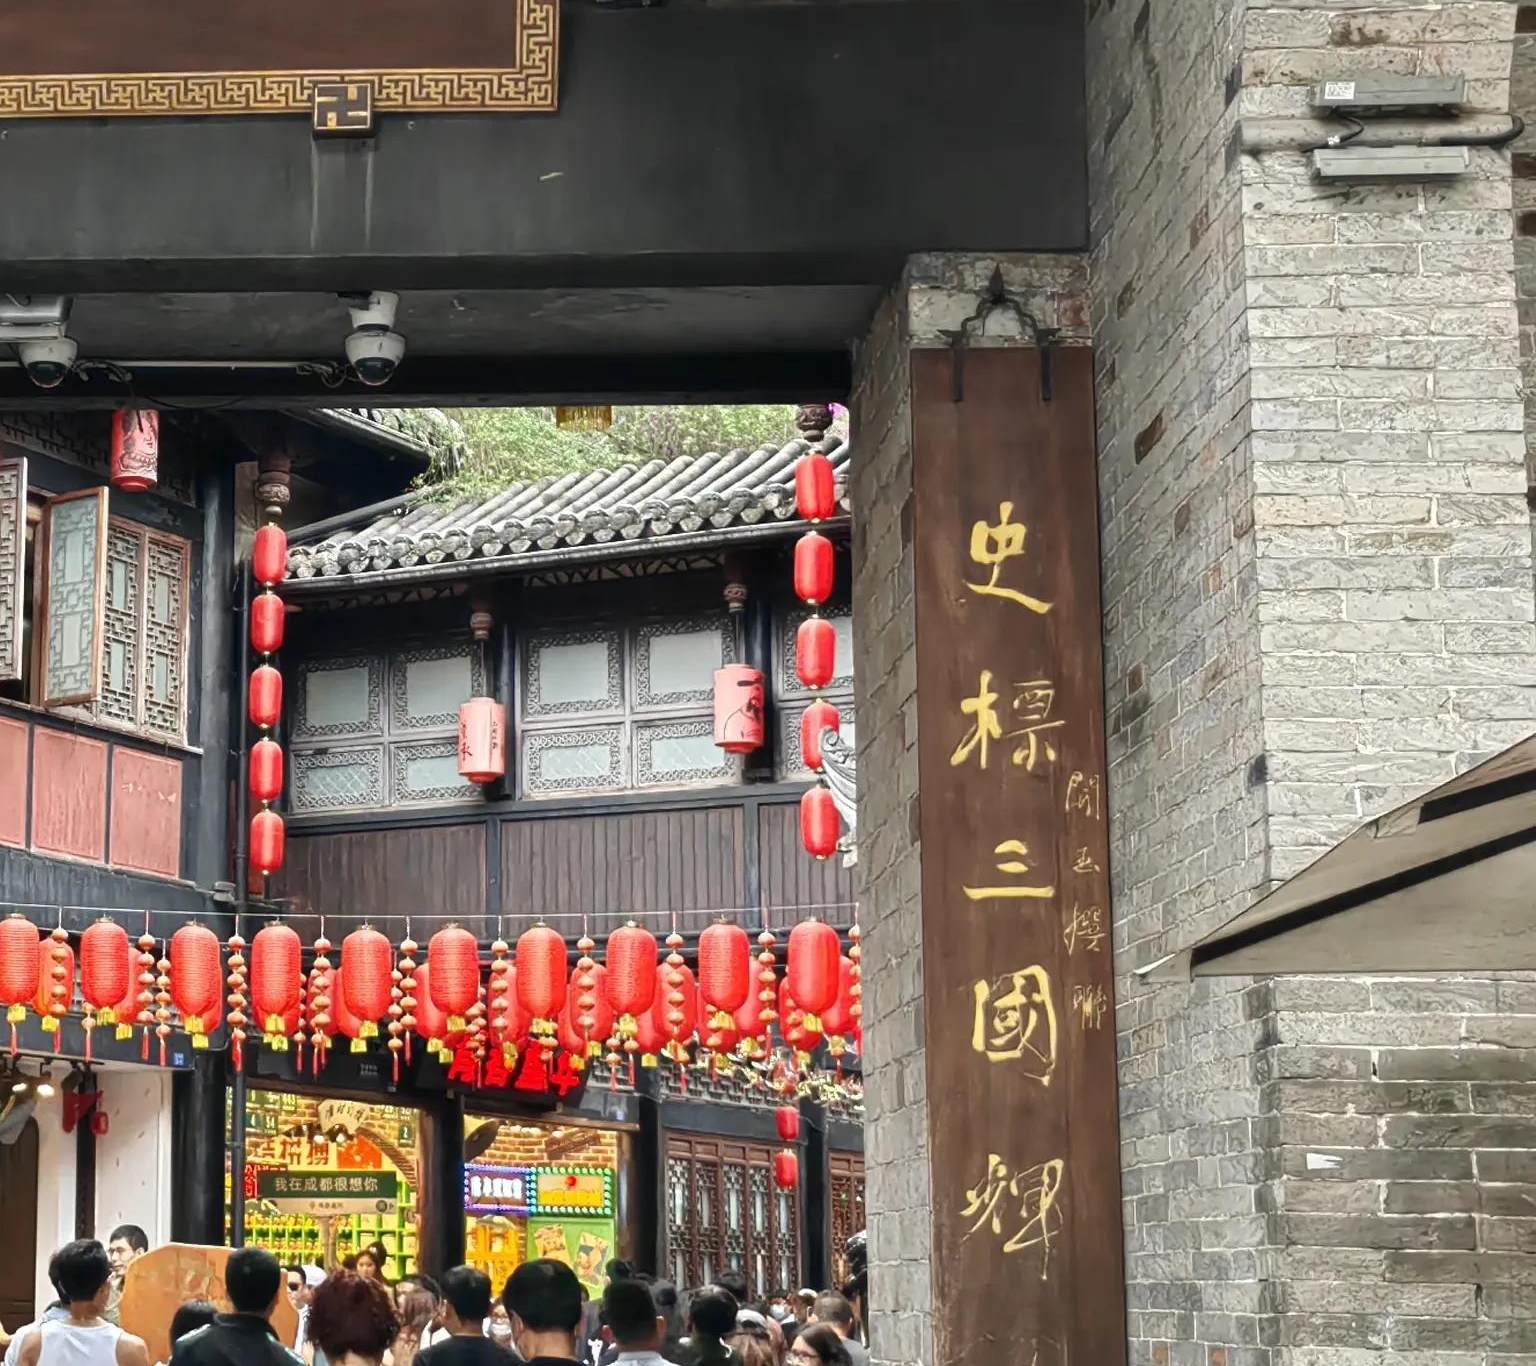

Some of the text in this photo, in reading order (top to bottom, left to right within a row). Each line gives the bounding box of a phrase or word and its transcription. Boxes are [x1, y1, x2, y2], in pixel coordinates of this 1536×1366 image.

[274, 1176, 379, 1193] 我在成都很想你
